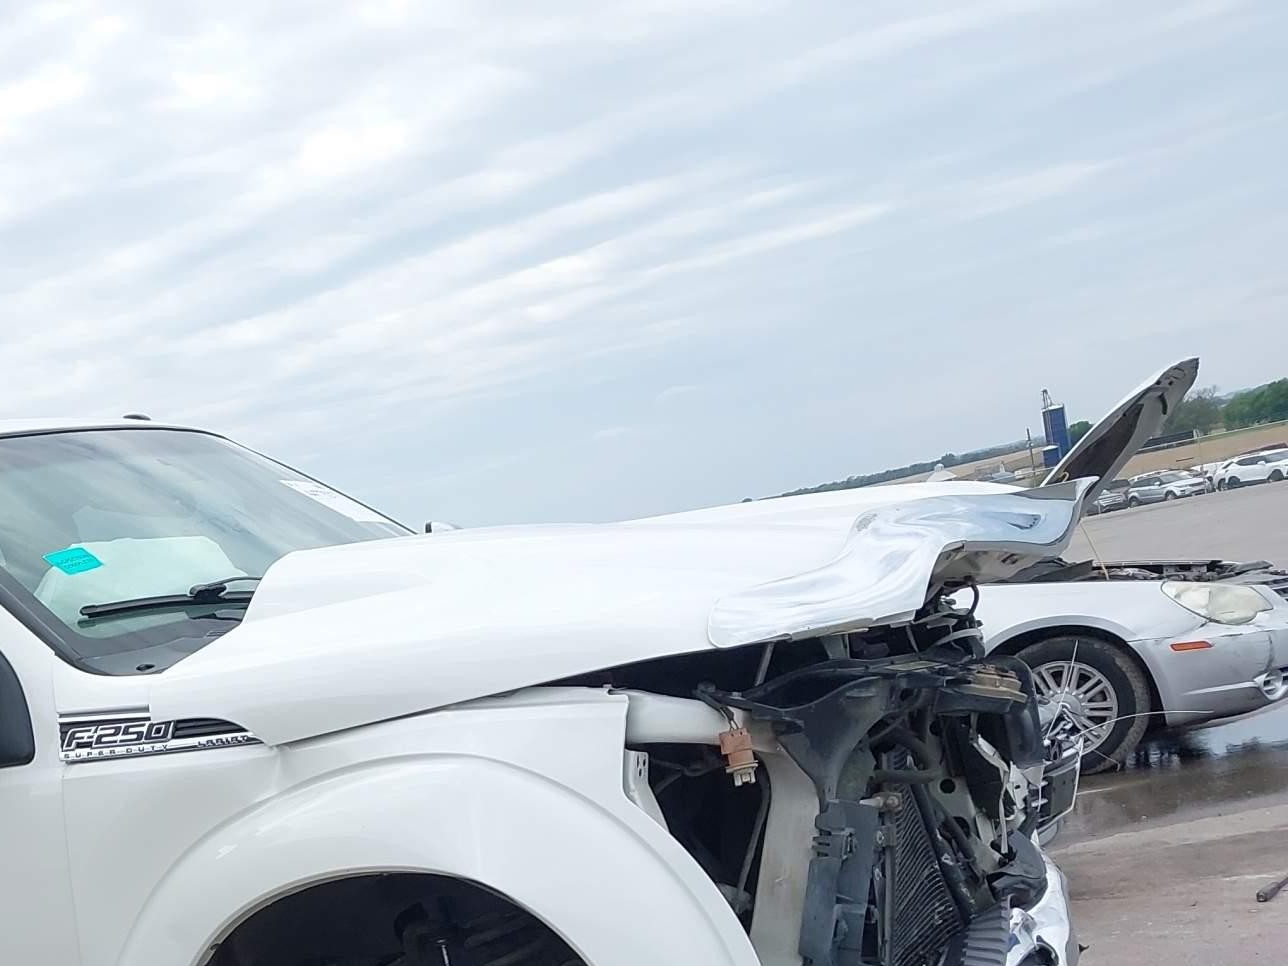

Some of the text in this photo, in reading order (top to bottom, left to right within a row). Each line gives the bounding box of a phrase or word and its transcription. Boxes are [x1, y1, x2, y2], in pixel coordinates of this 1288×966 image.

[62, 721, 173, 750] F-250
[63, 744, 168, 759] SUPER DUTY
